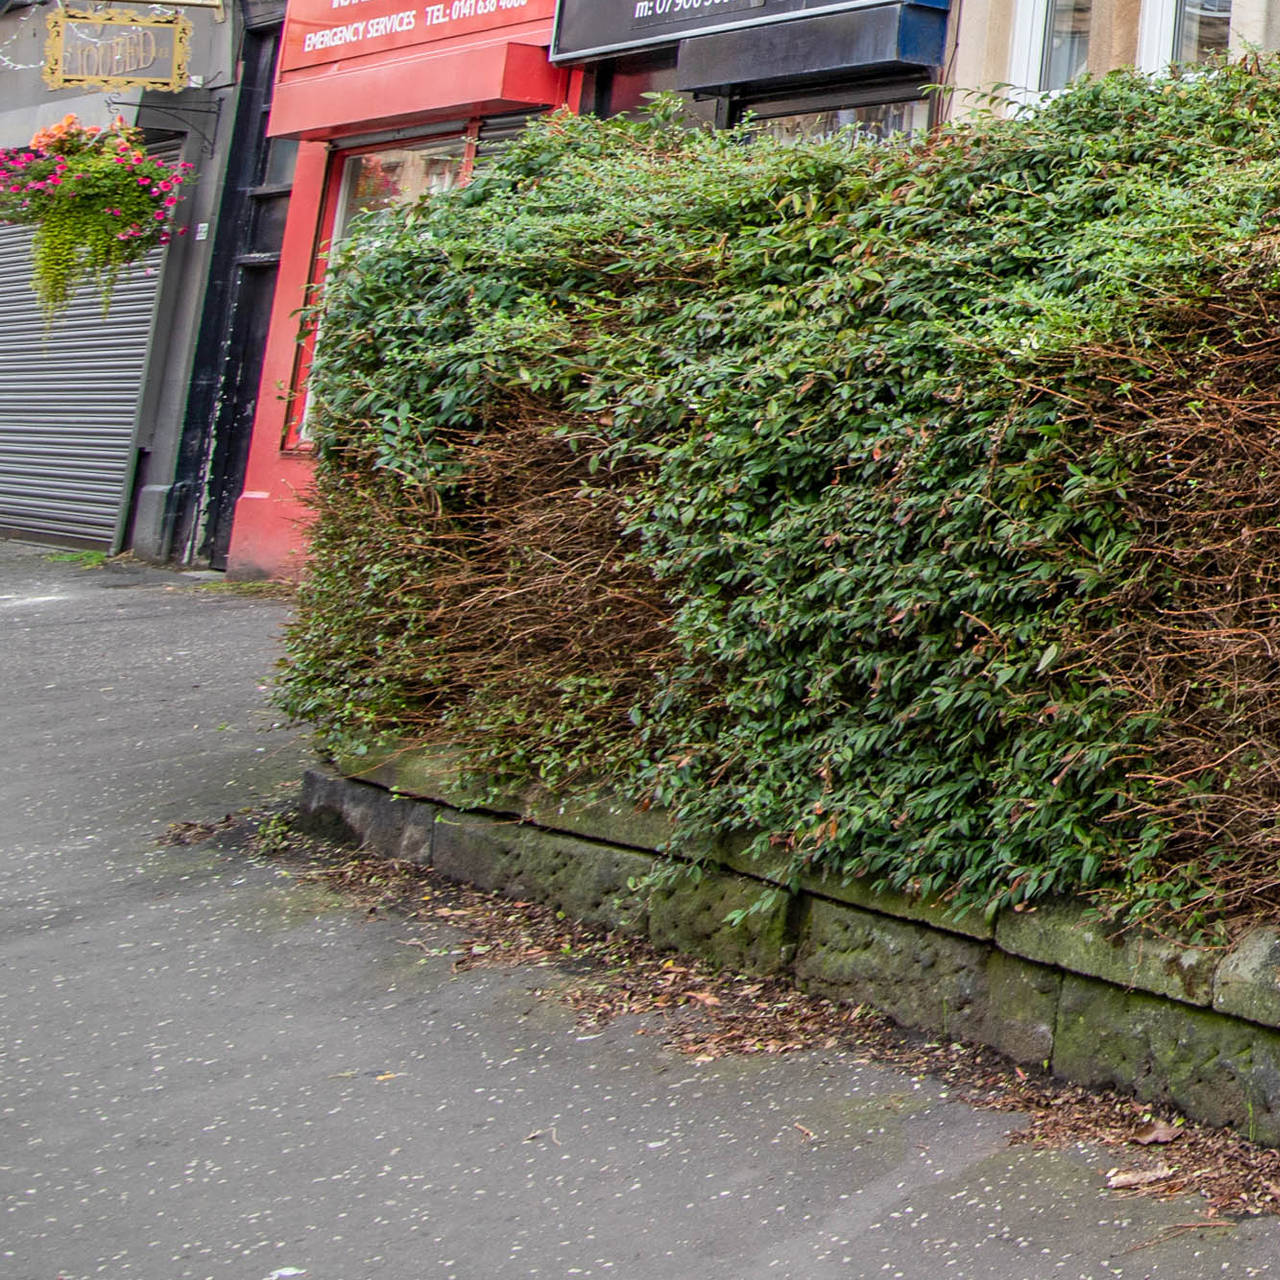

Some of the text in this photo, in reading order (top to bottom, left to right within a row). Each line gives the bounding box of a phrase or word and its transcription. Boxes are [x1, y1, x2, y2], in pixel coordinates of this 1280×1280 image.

[304, 21, 365, 52] EMERGENCY
[366, 10, 416, 38] SERVICES
[425, 5, 450, 25] TEL:
